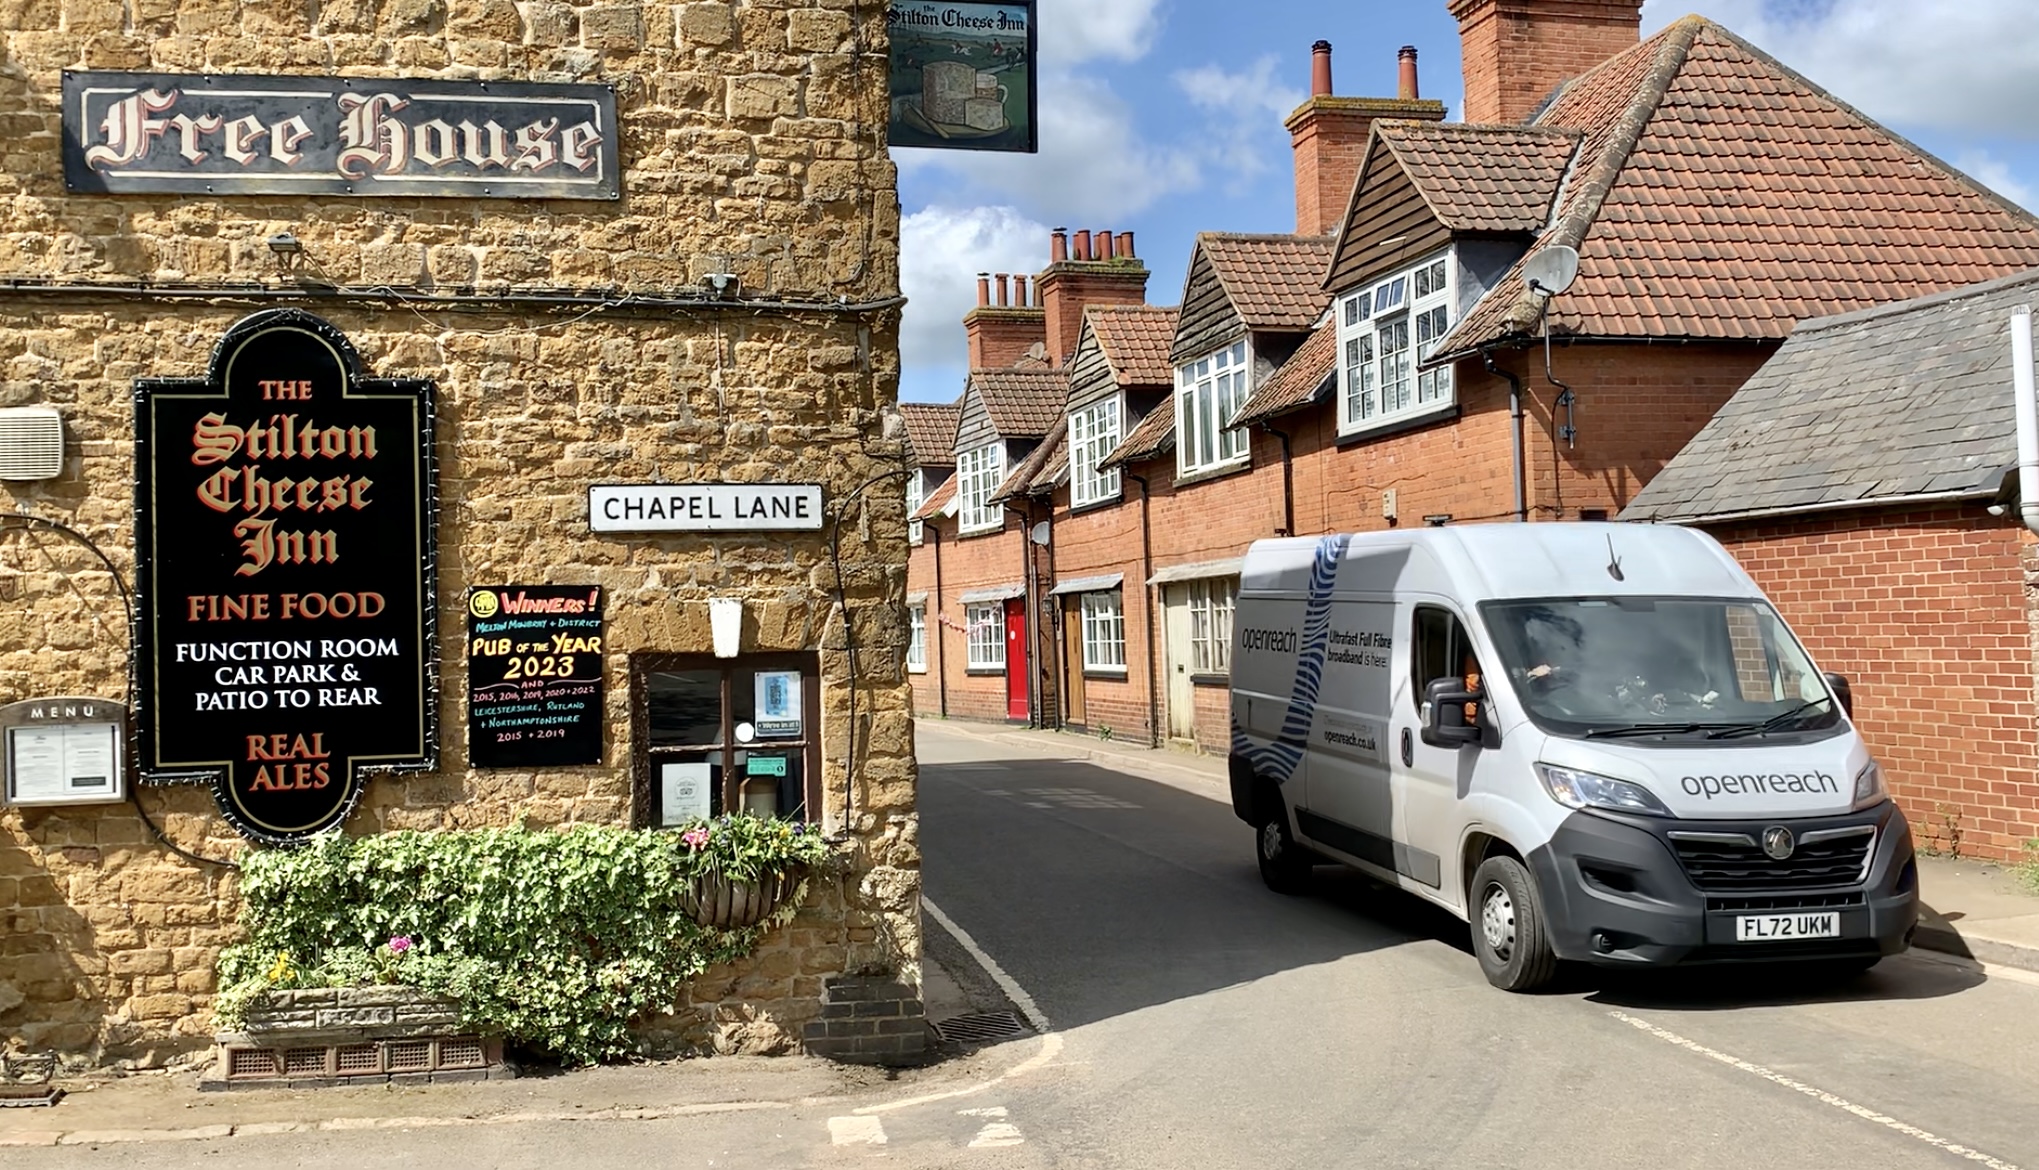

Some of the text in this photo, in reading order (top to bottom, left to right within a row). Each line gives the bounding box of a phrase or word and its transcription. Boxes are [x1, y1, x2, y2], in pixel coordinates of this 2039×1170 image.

[942, 8, 994, 30] Cheese
[997, 10, 1025, 31] Inn
[84, 88, 603, 180] Free House
[258, 380, 313, 400] THE
[191, 411, 378, 465] Stilton
[197, 465, 374, 518] Cheese
[604, 496, 809, 520] CHAPEL LANE
[233, 517, 339, 577] Inn
[187, 592, 385, 622] FINE FOOD
[558, 618, 601, 627] DISTRICT
[176, 638, 399, 662] FUNCTION ROOM
[472, 632, 602, 656] PUB OF THE YEAR
[1242, 627, 1297, 653] openreach
[1329, 630, 1358, 646] Ultrafast
[1359, 632, 1372, 647] Full
[1328, 647, 1363, 665] broadband
[215, 663, 361, 686] CAR PARK &
[503, 656, 574, 680] 2023
[521, 680, 544, 689] AND
[572, 686, 595, 695] 2022
[195, 687, 382, 711] PATIO TO REAR
[546, 701, 585, 711] RUTLAND
[31, 706, 94, 718] MENU
[488, 715, 581, 728] NORTHAMPTONSHIRE
[246, 732, 331, 761] REAL
[497, 731, 522, 742] 2015
[537, 728, 565, 739] 2019
[1324, 731, 1376, 750] openreach.co.uk
[249, 762, 330, 792] ALES
[1681, 770, 1839, 800] openreach
[1745, 915, 1832, 937] FL72 UKM
